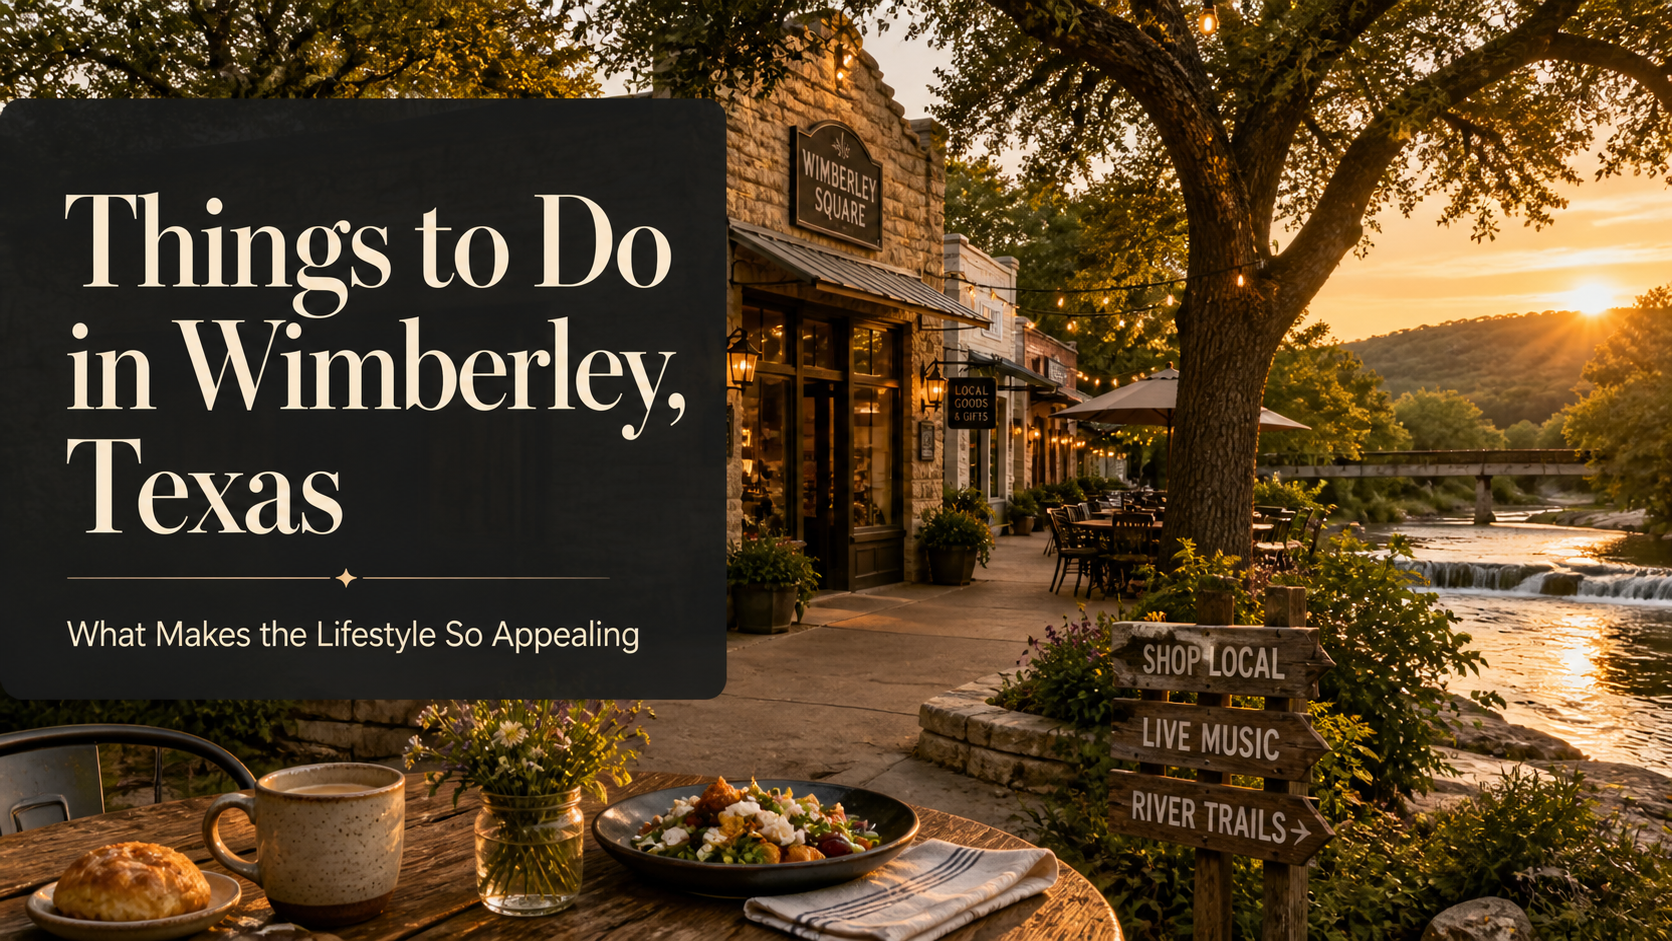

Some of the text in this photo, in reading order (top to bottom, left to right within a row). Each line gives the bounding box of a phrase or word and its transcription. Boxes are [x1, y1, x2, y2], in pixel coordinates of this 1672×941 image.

[802, 148, 876, 203] WIMBERLEY
[815, 187, 866, 228] SQUARE
[954, 385, 989, 396] LOCAL
[954, 398, 989, 409] GOODS
[963, 411, 989, 422] GIFTS
[1142, 643, 1286, 680] SHOP LOCAL
[1142, 717, 1280, 762] LIVE MUSIC
[1131, 790, 1287, 845] RIVER TRAILS
